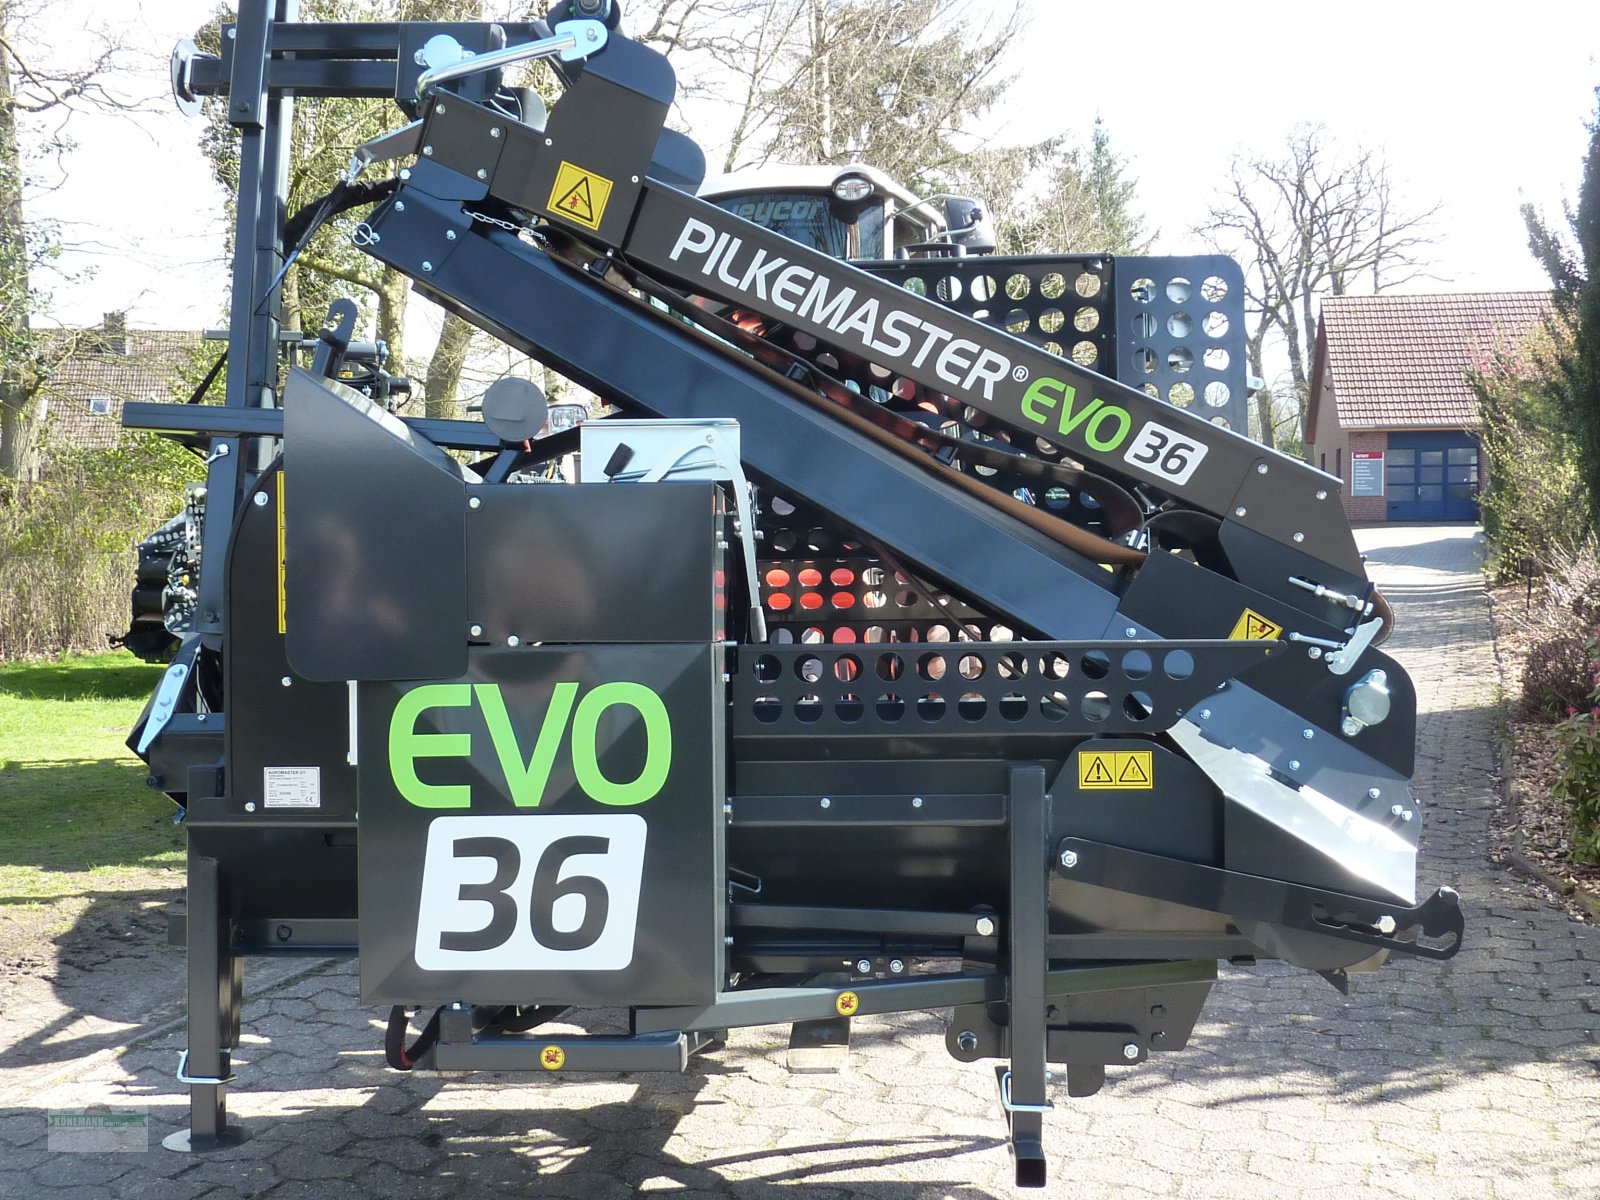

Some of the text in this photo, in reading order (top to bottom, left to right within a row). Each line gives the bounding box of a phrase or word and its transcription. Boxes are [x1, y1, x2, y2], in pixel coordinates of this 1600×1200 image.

[1020, 376, 1132, 453] EVO
[1133, 429, 1195, 476] 36
[388, 681, 672, 809] EVO
[439, 835, 610, 952] 36
